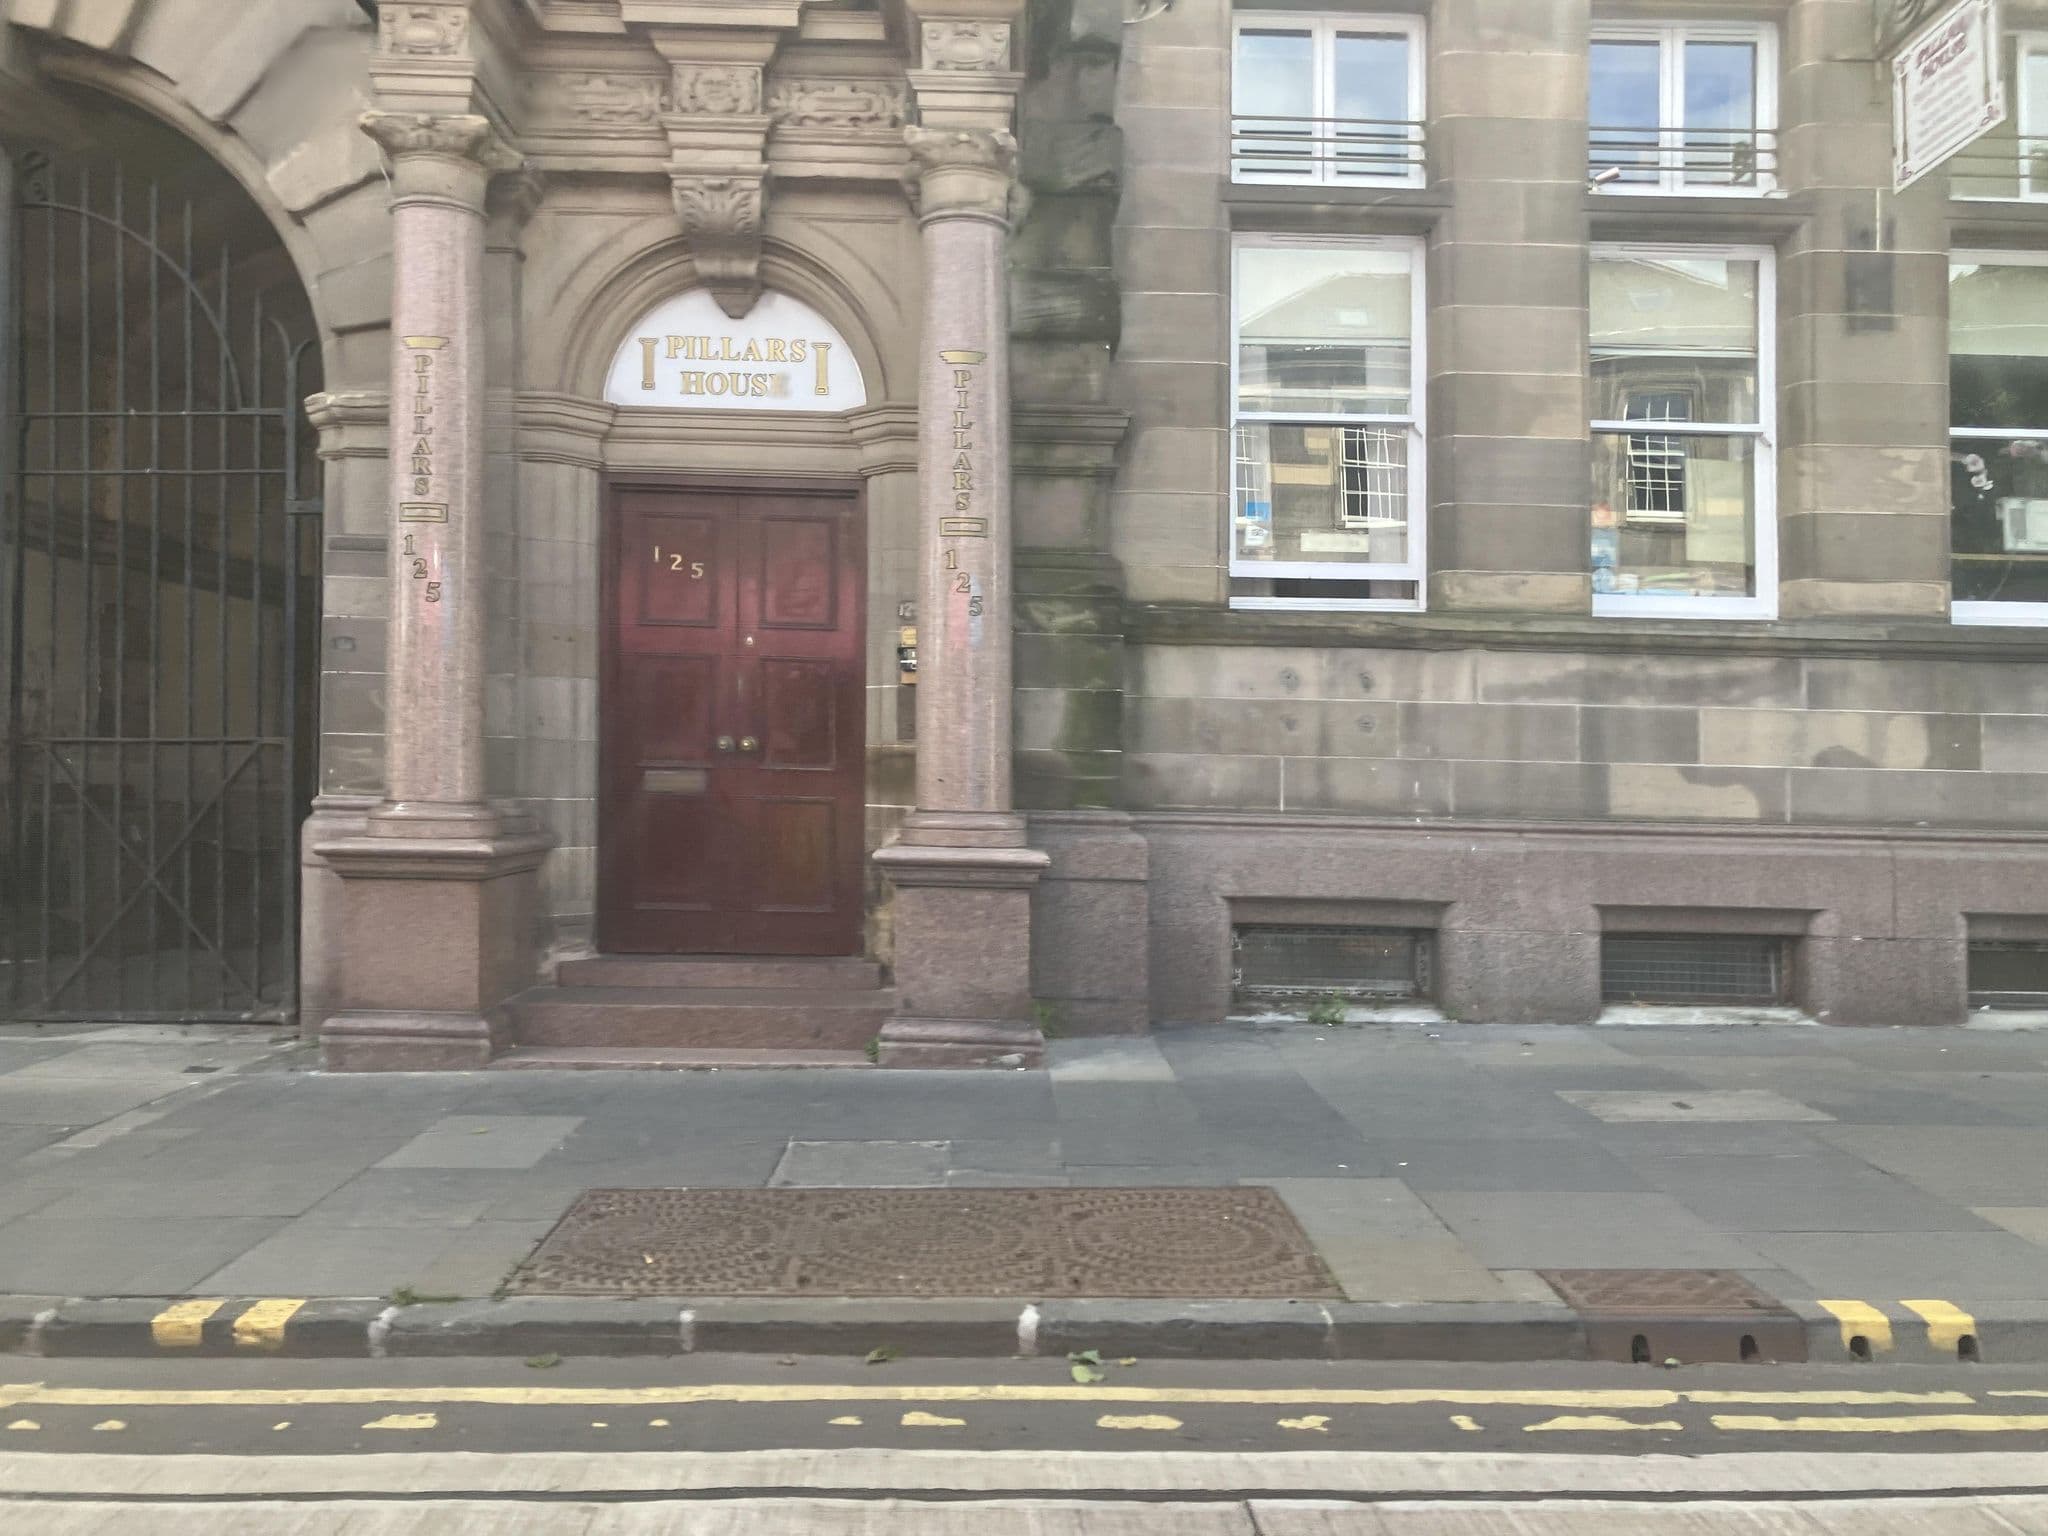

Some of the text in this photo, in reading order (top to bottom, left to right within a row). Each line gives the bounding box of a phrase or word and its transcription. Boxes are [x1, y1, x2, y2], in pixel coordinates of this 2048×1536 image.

[665, 335, 807, 363] PILLARS
[411, 354, 433, 496] PILLARS
[952, 369, 974, 511] PILLARS
[403, 533, 441, 602] 125
[653, 545, 705, 579] 125
[944, 549, 984, 617] 125
